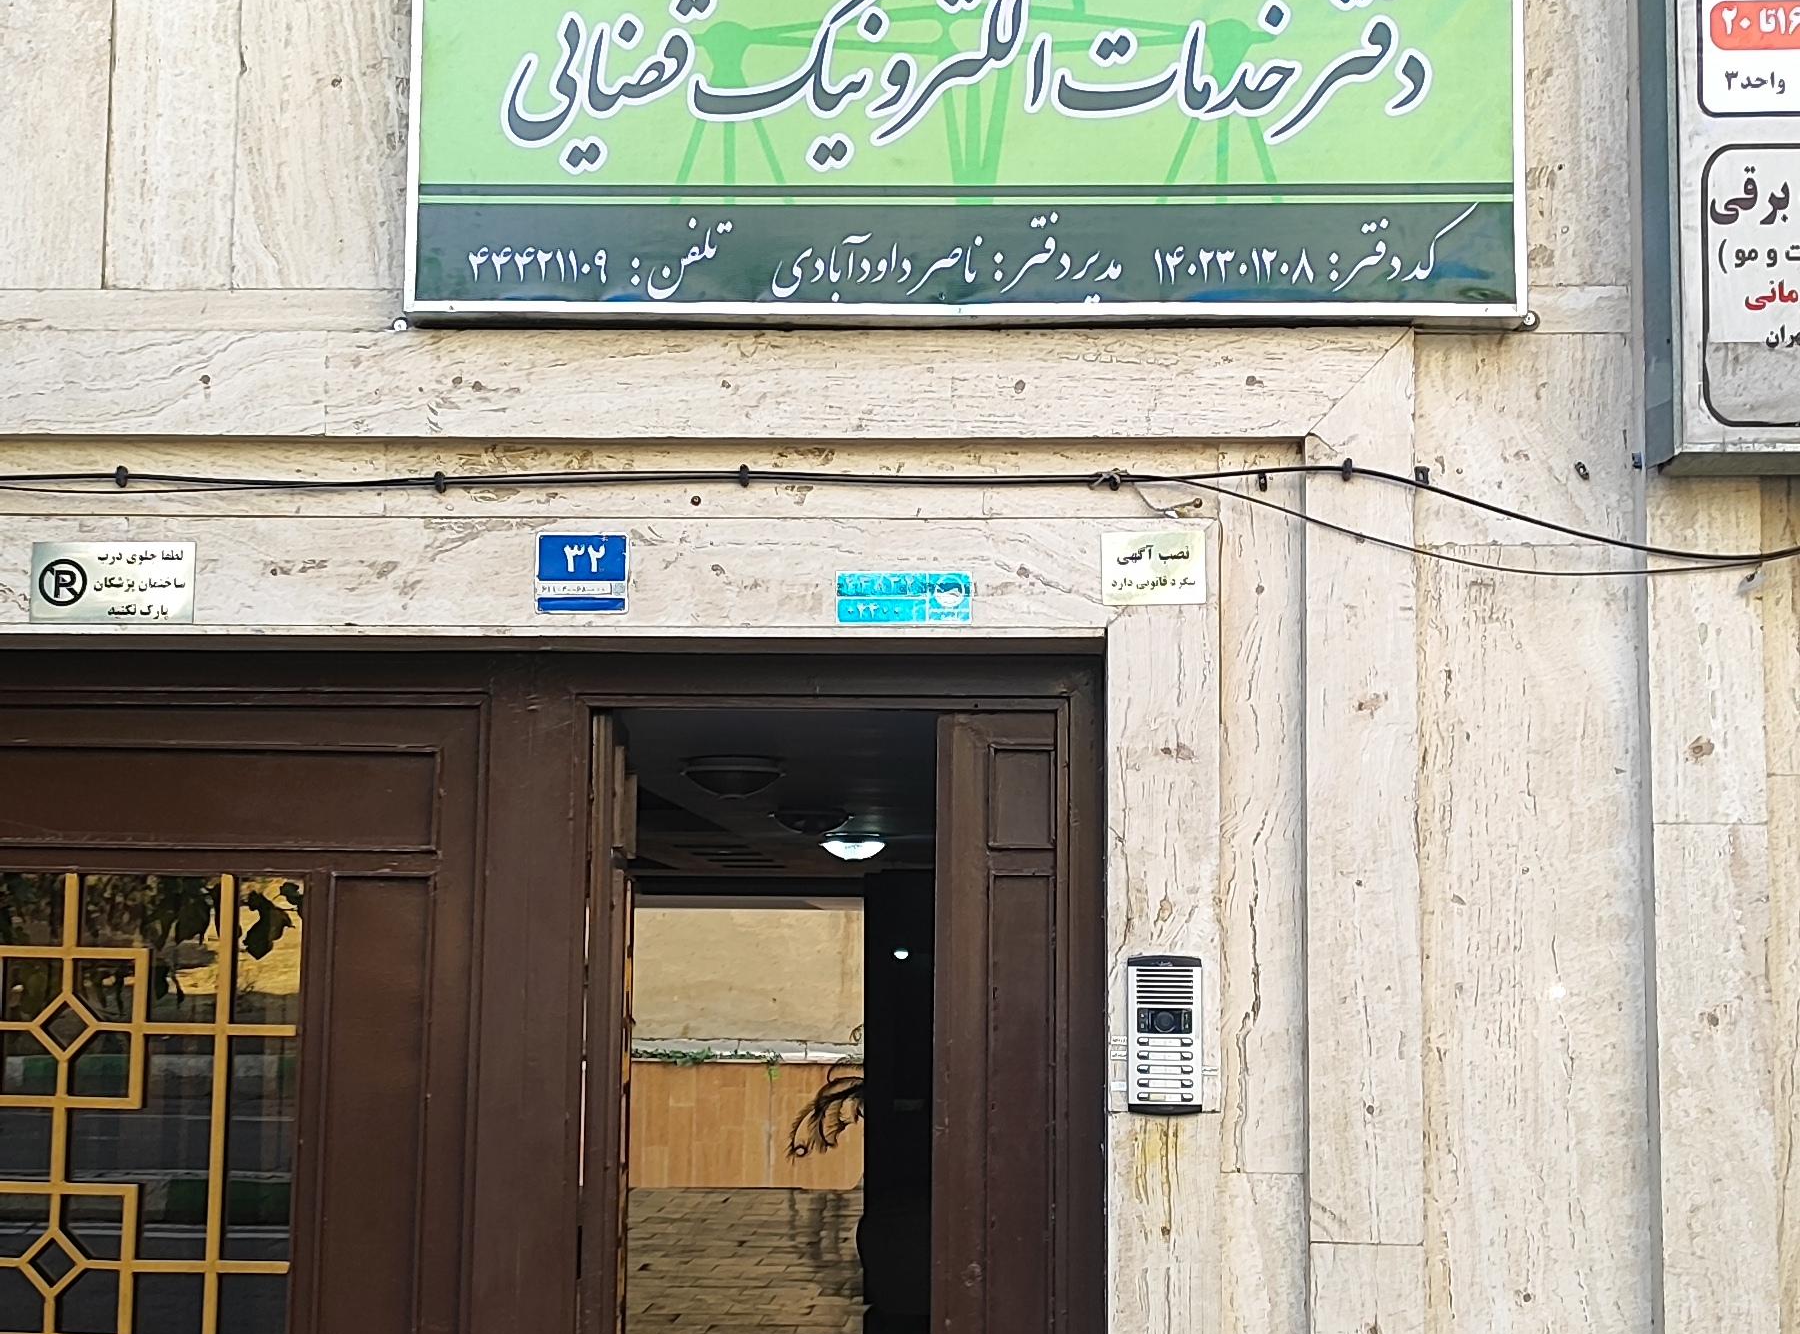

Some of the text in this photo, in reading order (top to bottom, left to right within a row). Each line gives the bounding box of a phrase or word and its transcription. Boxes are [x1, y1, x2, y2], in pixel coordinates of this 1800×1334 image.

[1058, 4, 1297, 115] خدمات
[1709, 165, 1790, 226] برقی
[1401, 201, 1481, 281] کد
[467, 245, 609, 284] ۴۴۴۲۱۱۰۹
[906, 234, 984, 295] ناصر
[1153, 247, 1315, 285] ۱۴۰۲۳۰۱۲۰۸
[1734, 247, 1759, 268] مو
[1766, 247, 1778, 268] و
[1072, 247, 1123, 304] مدیر
[1744, 278, 1800, 311] مانی
[97, 549, 184, 566] لطفا جلوی درب
[563, 543, 606, 573] ۳۲
[1116, 544, 1190, 566] نصب آگهی
[93, 576, 186, 593] ساختمان پزشکان
[1111, 577, 1134, 591] دارد
[1135, 575, 1168, 591] قانونی
[107, 603, 169, 621] پارک نکنید
